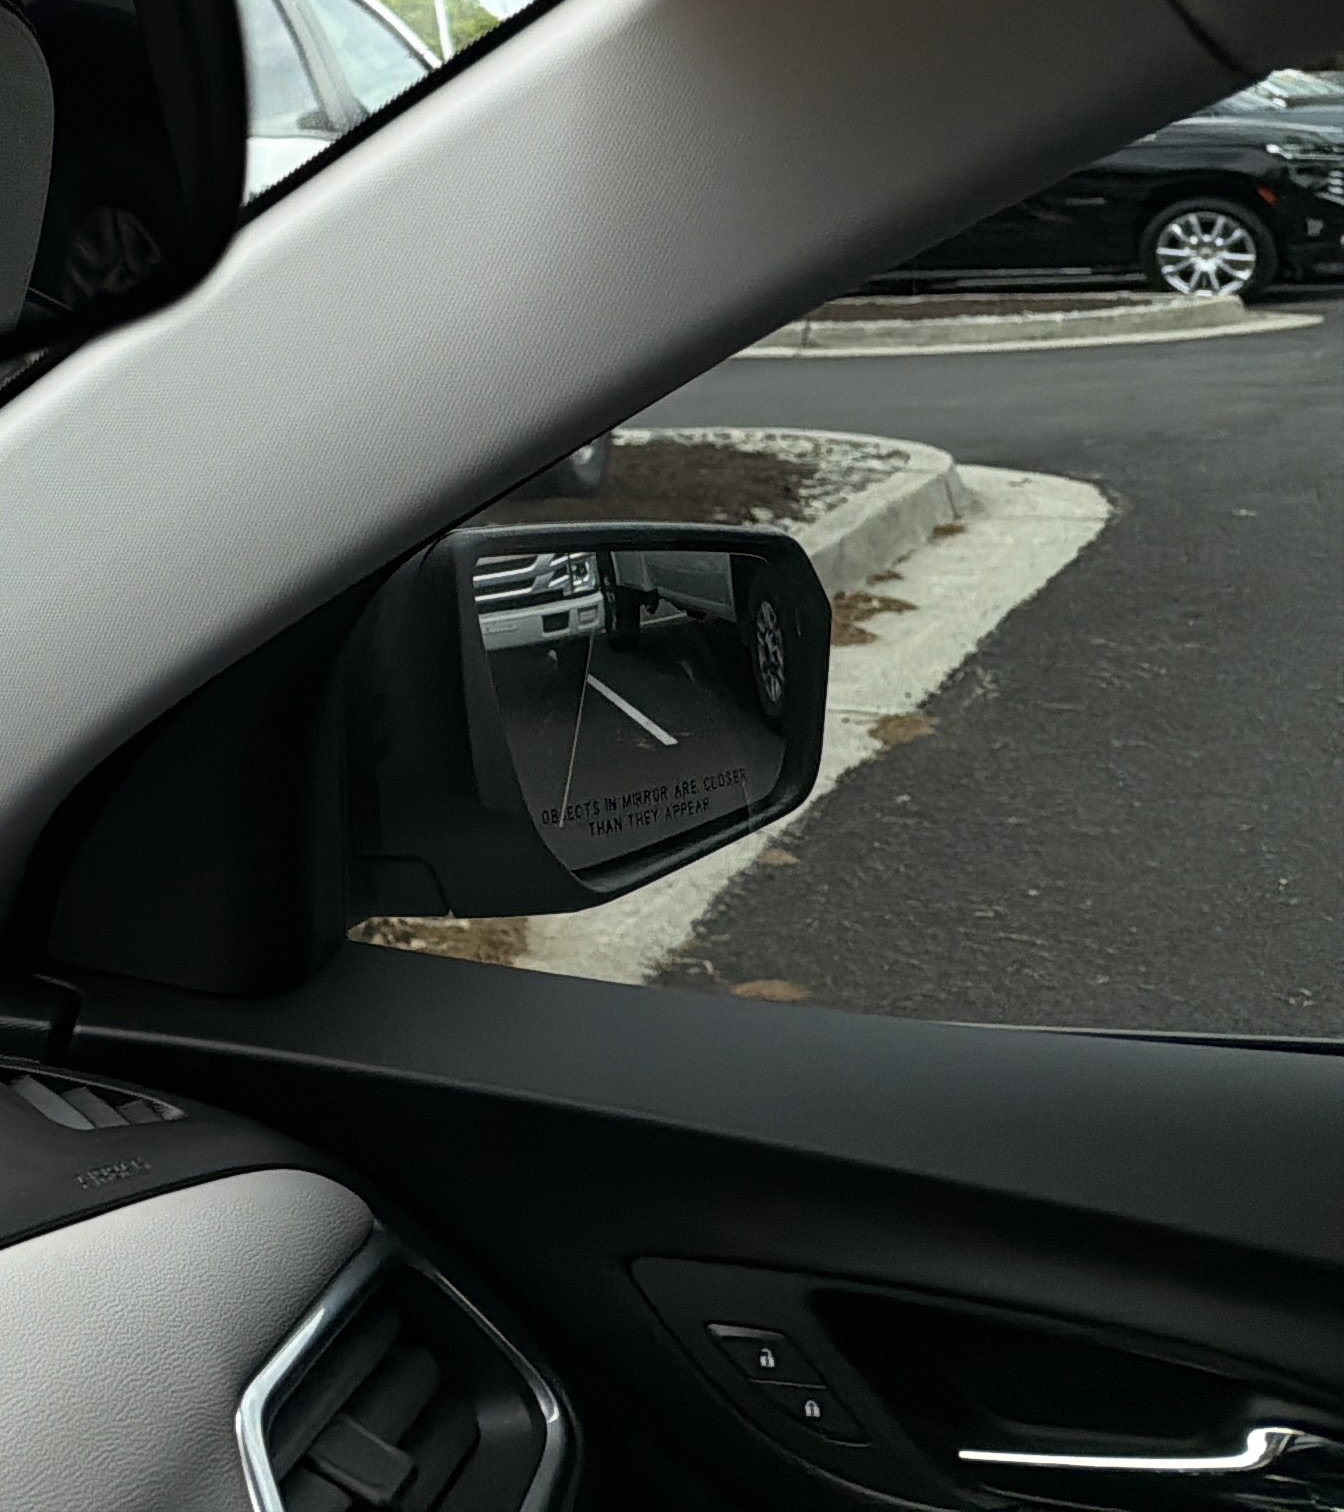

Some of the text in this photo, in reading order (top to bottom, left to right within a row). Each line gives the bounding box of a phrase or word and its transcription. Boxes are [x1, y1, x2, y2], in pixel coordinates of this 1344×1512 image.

[605, 797, 617, 812] IN
[621, 786, 669, 809] MIRROR
[674, 780, 697, 797] ARE
[588, 798, 710, 837] THAN THEY APPEAR
